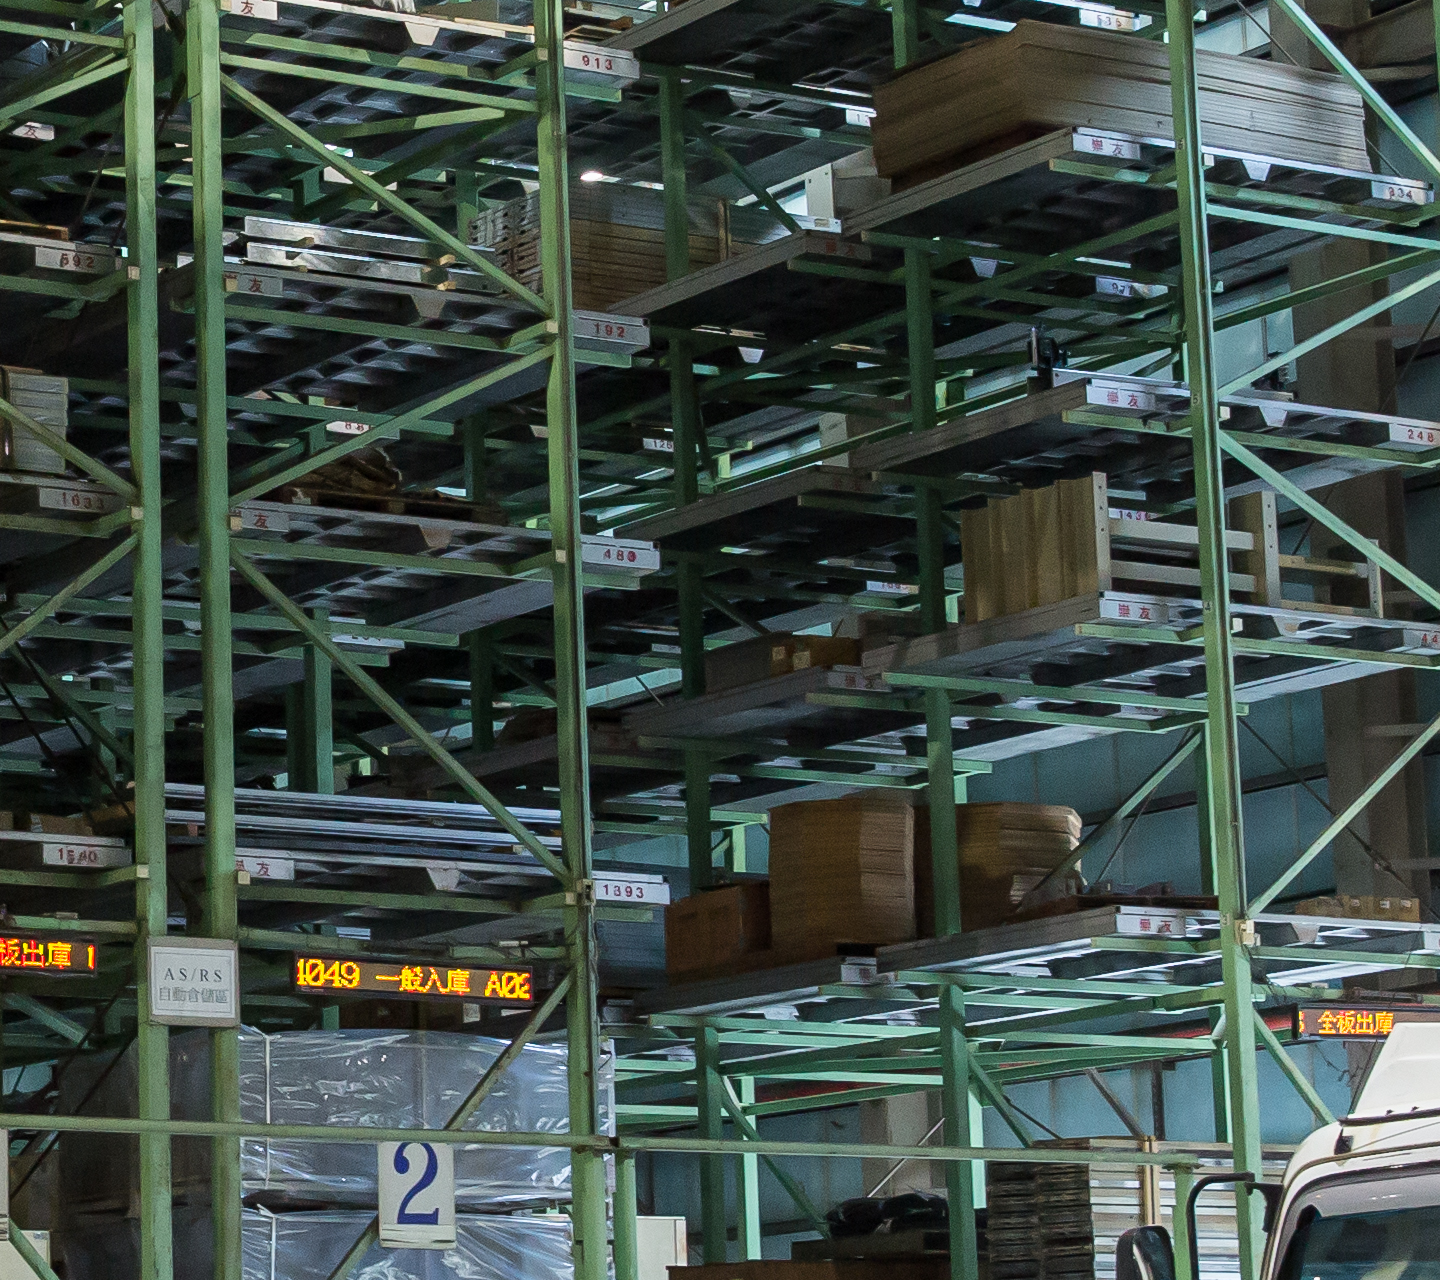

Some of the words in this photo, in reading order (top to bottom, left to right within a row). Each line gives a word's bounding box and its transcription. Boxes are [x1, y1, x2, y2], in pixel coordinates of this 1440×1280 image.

[581, 54, 614, 71] 913
[602, 883, 645, 900] 1393
[375, 965, 471, 996] 一般入庫
[1317, 1009, 1396, 1036] 全板出庫
[392, 1141, 440, 1226] 2
